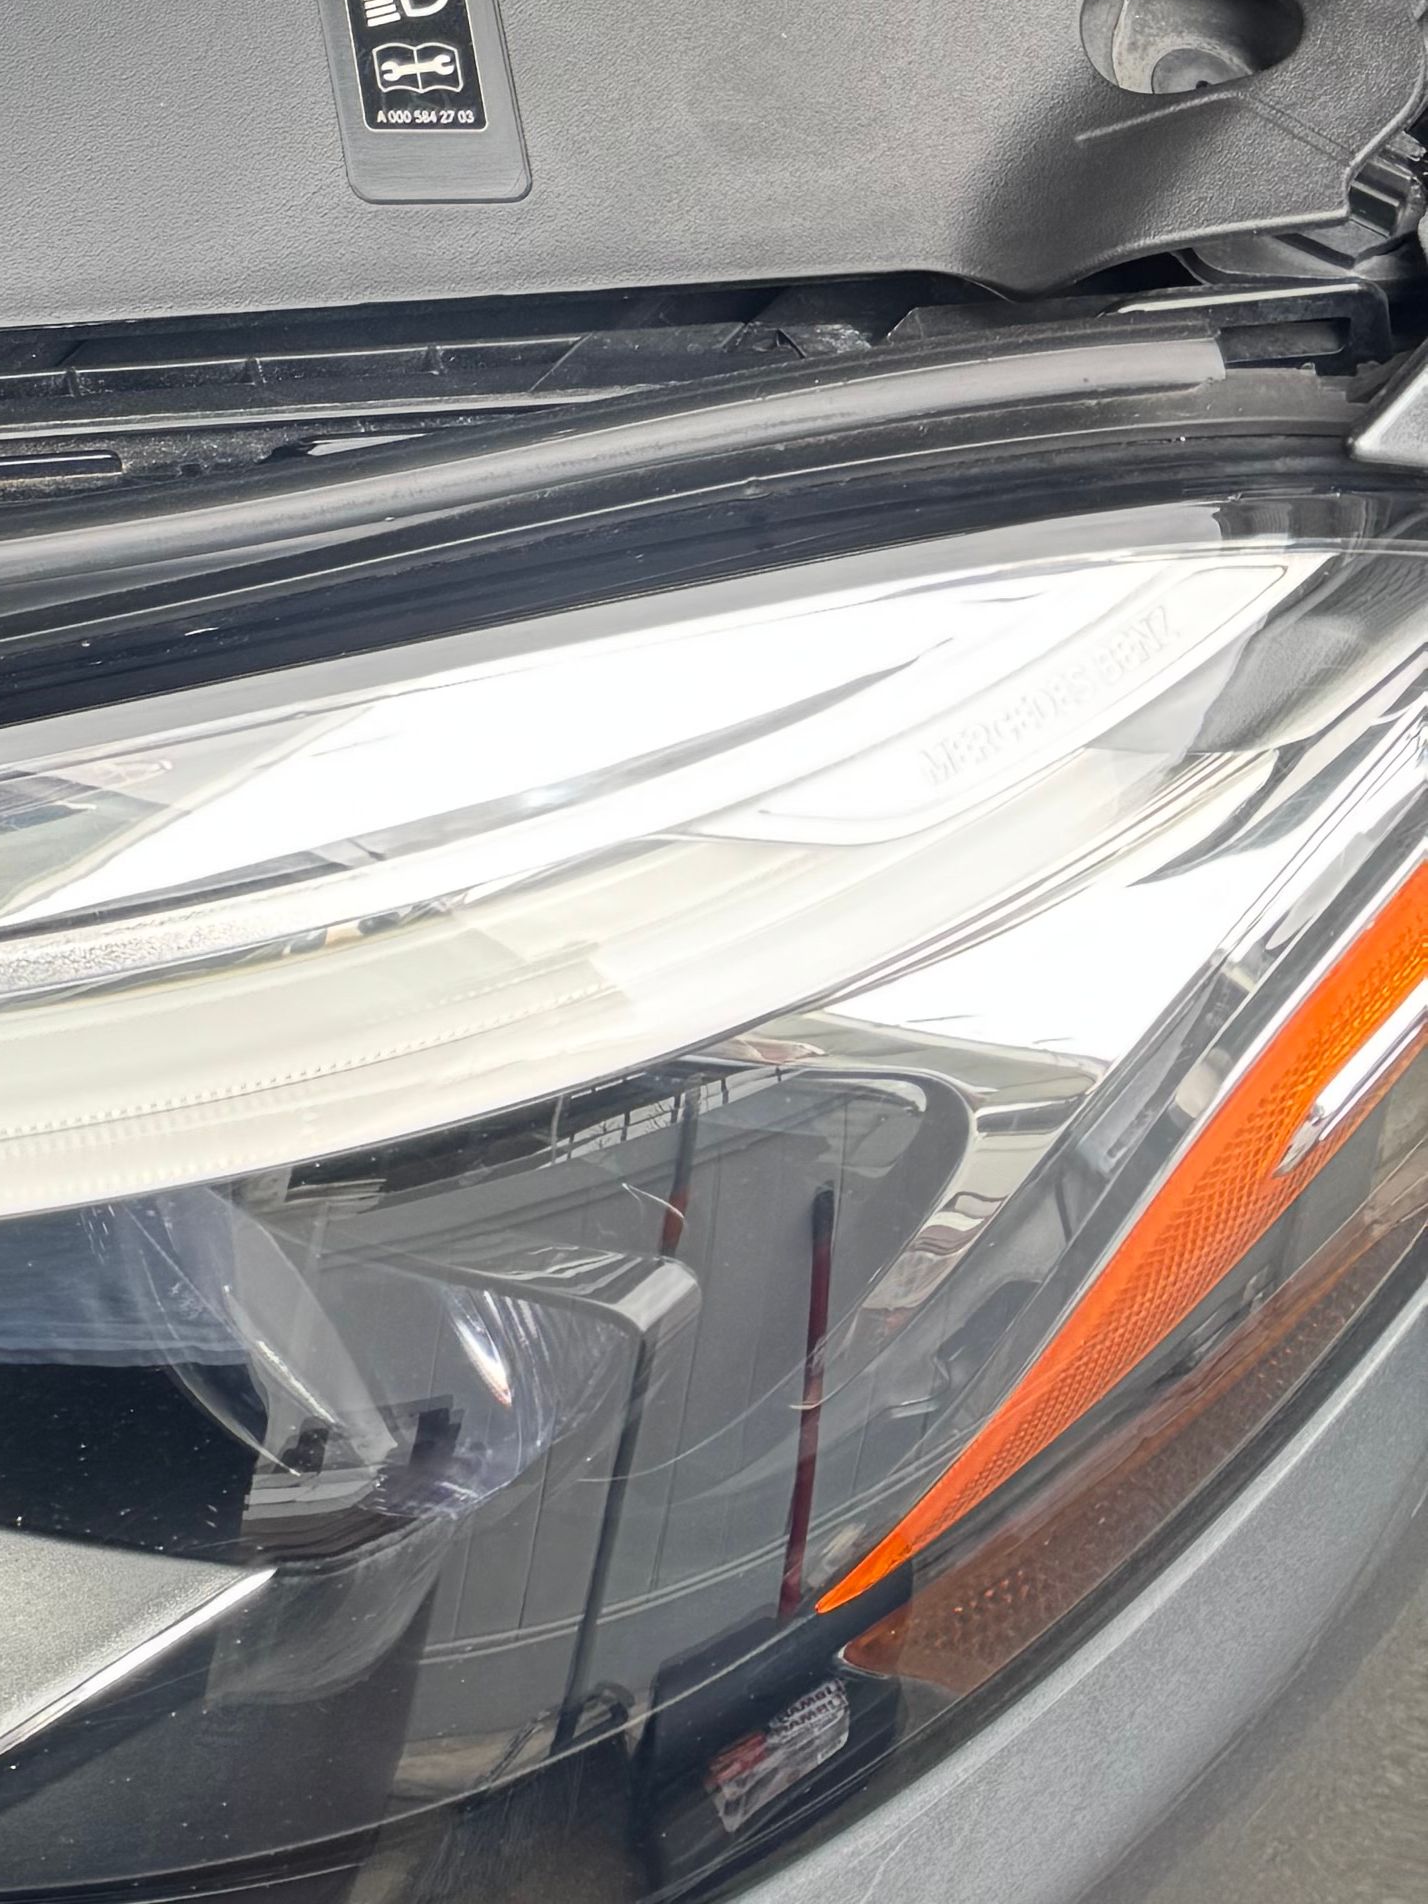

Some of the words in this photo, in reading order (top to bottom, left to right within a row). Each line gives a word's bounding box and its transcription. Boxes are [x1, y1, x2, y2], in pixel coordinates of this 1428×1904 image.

[377, 110, 387, 123] A
[390, 110, 411, 123] 000
[414, 110, 437, 123] 584
[440, 110, 454, 123] 27
[458, 110, 475, 123] 03
